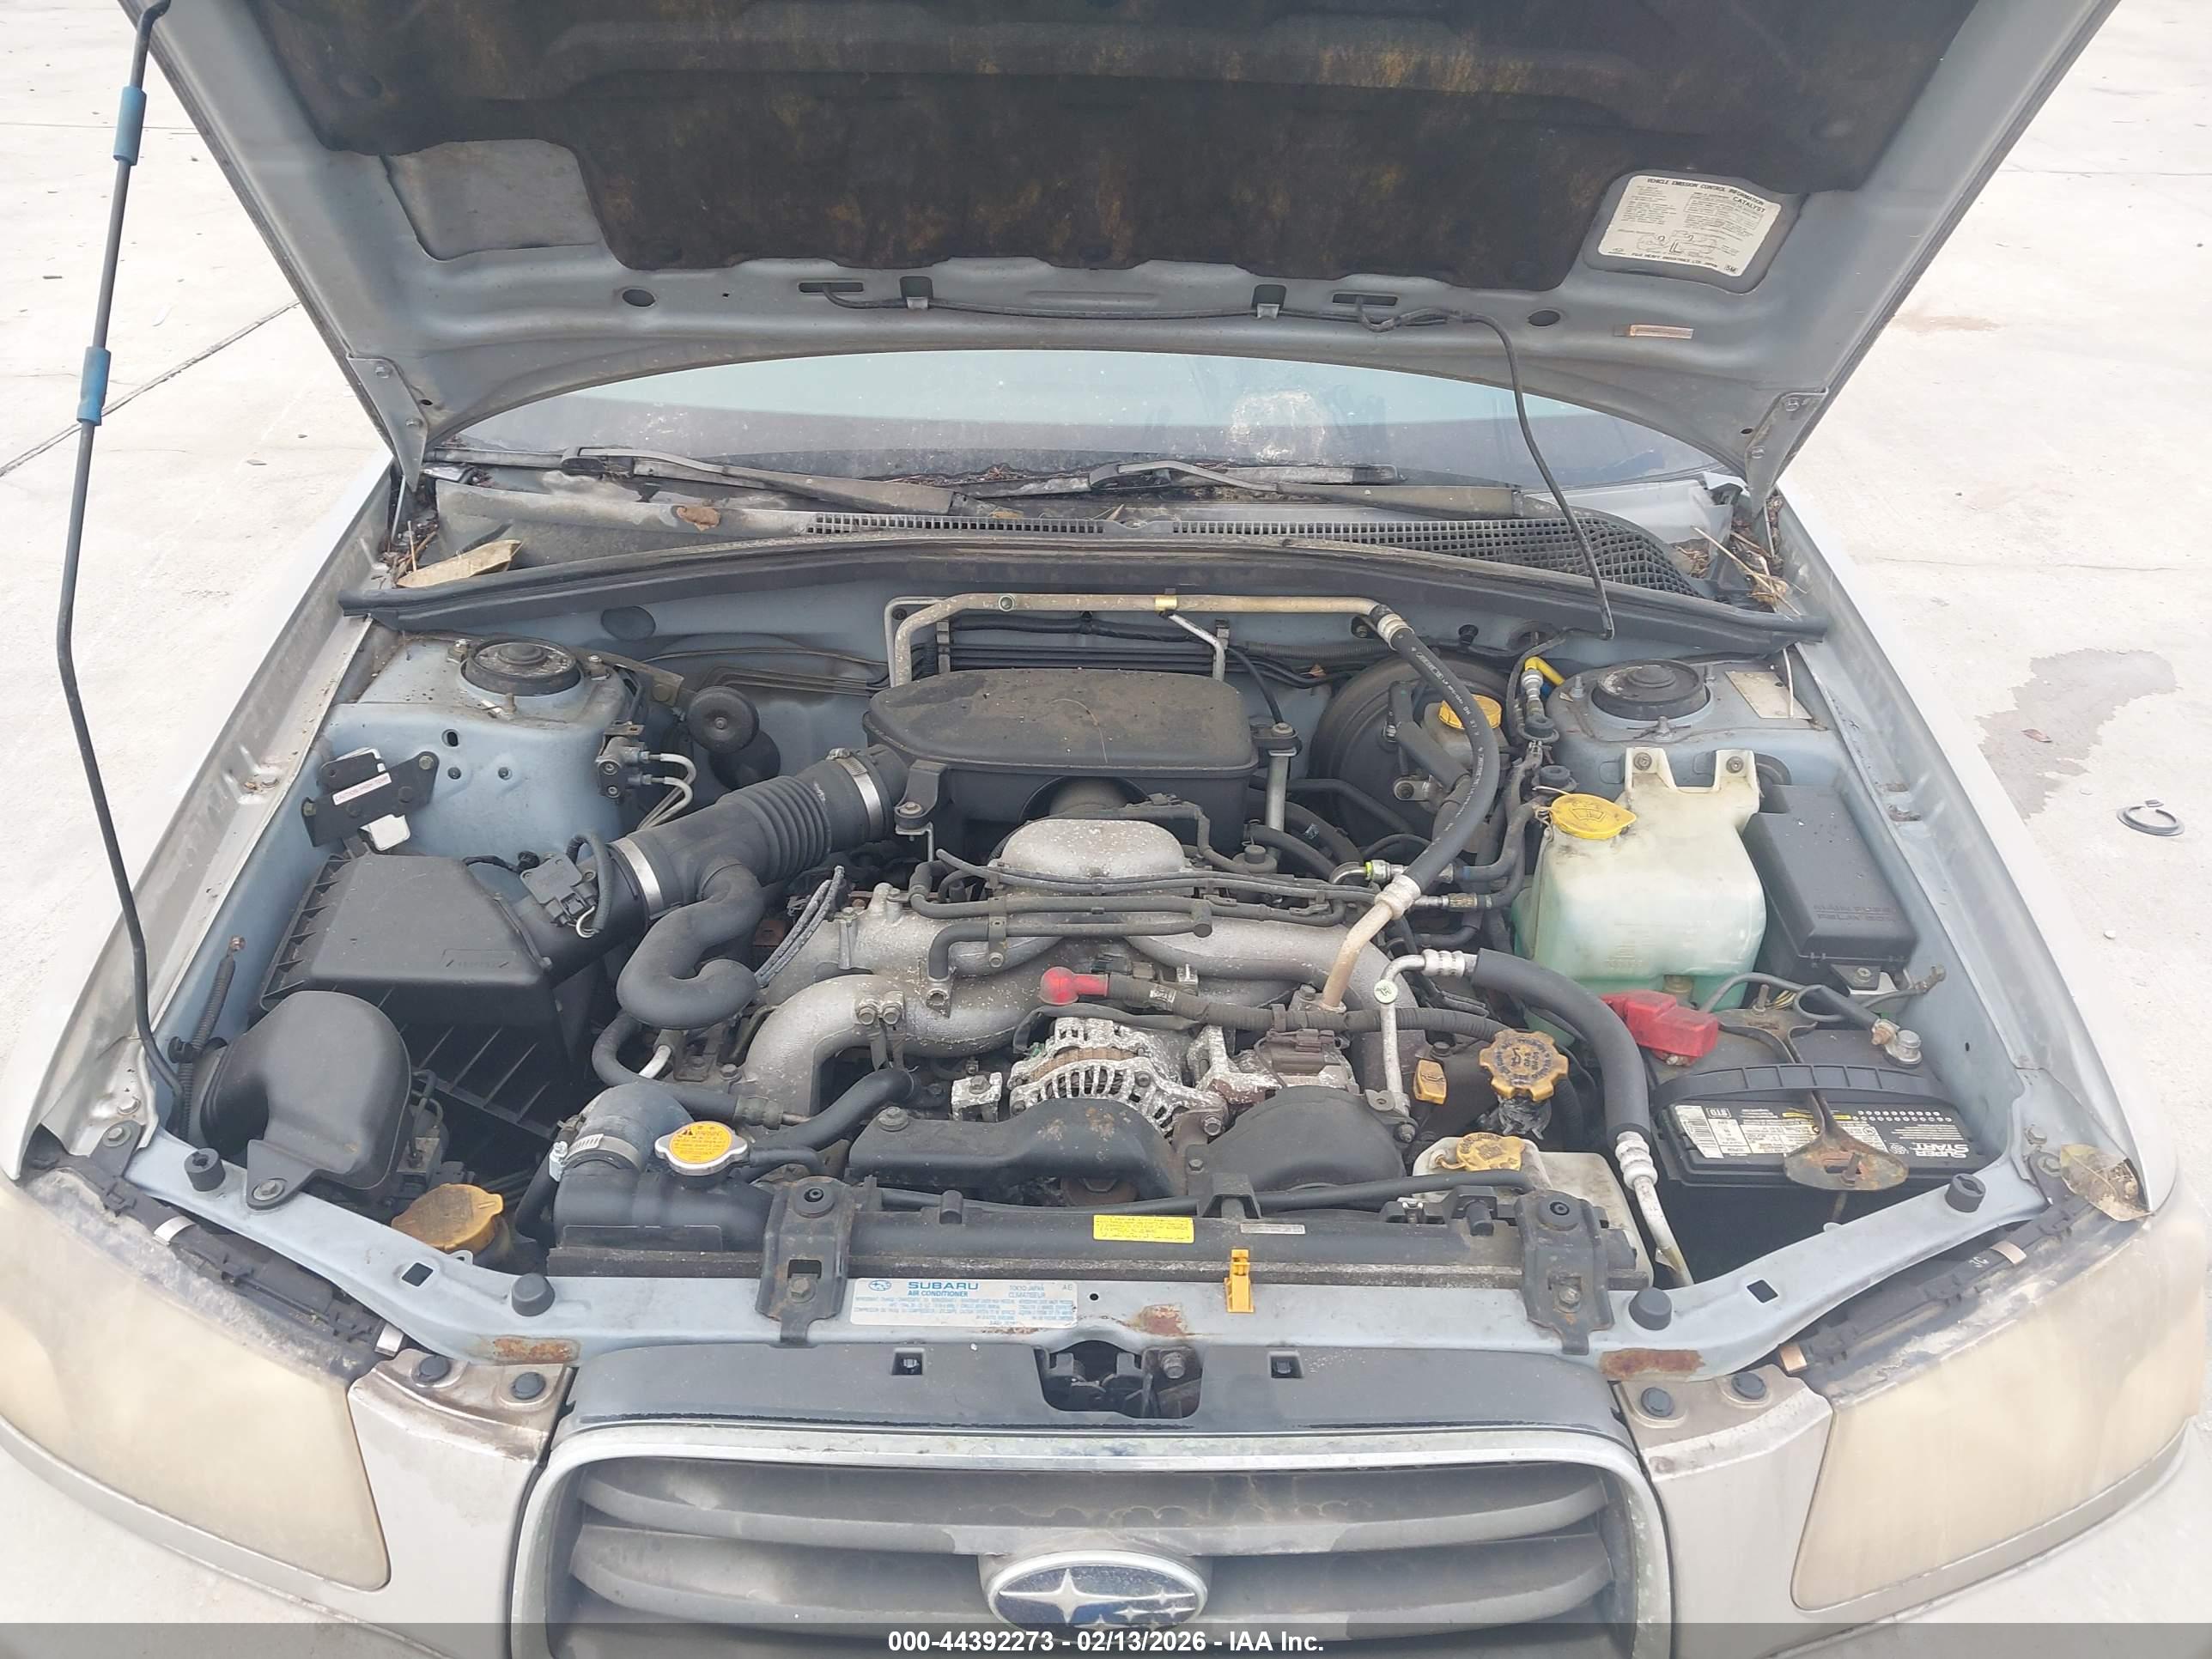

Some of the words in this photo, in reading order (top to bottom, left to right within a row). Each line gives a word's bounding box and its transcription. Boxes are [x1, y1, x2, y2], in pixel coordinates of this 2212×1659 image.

[1700, 184, 1725, 192] CONTROL
[1732, 197, 1766, 214] CATALYST
[1911, 1142, 1968, 1152] START
[908, 1281, 979, 1291] SUBARU
